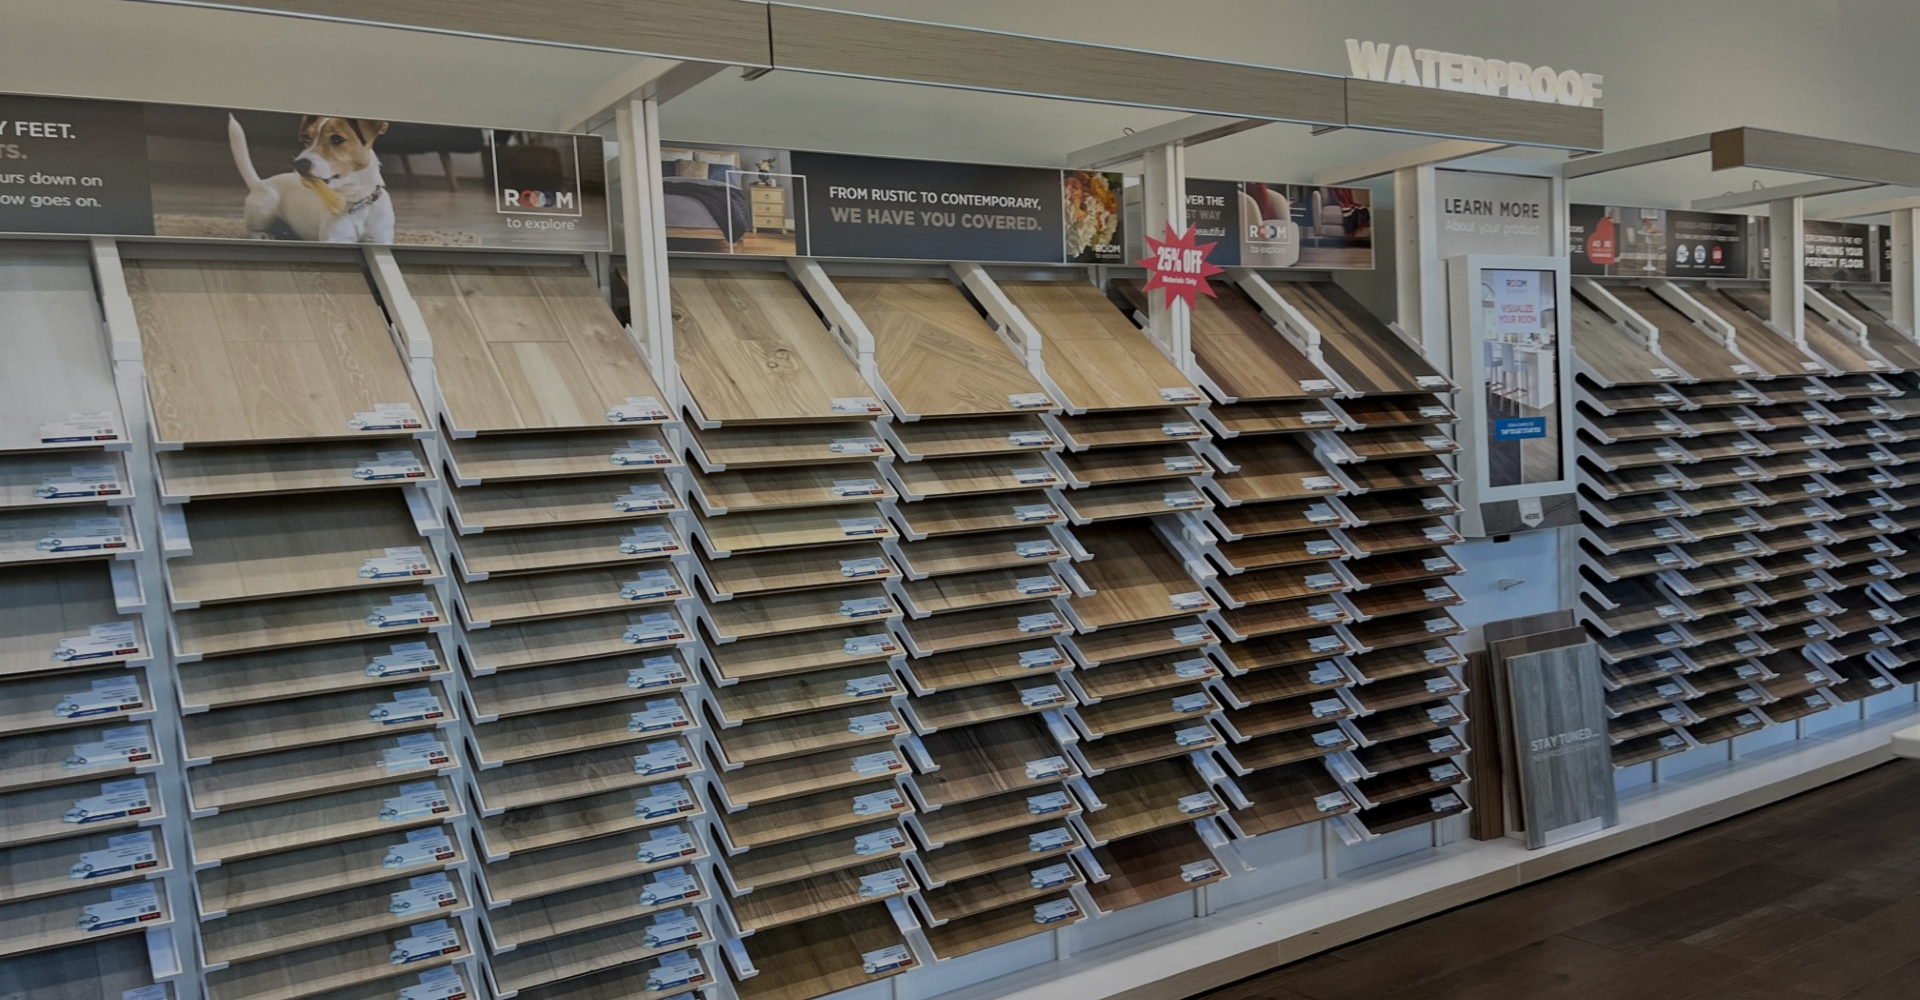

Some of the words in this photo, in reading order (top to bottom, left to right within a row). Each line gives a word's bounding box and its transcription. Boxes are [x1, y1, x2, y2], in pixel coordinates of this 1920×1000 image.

[1344, 38, 1603, 107] WATERPROOF
[15, 121, 76, 139] FEET.
[29, 171, 76, 186] down
[80, 176, 103, 187] on
[29, 195, 71, 208] goes
[75, 196, 102, 207] on.
[504, 188, 573, 209] ROOM
[829, 186, 868, 200] FROM
[871, 188, 917, 203] RUSTIC
[919, 191, 937, 204] TO
[941, 193, 1041, 211] CONTEMPORARY,
[1205, 196, 1225, 207] THE
[1198, 210, 1221, 220] WAY
[1445, 198, 1493, 216] LEARN
[1500, 201, 1540, 219] MORE
[506, 217, 522, 228] to
[830, 206, 862, 224] WE
[867, 208, 915, 226] HAVE
[919, 211, 955, 228] YOU
[961, 213, 1041, 231] COVERED.
[1249, 225, 1286, 239] ROOM
[1157, 246, 1182, 272] 25%
[1183, 249, 1203, 274] OFF
[1531, 735, 1558, 752] STAY
